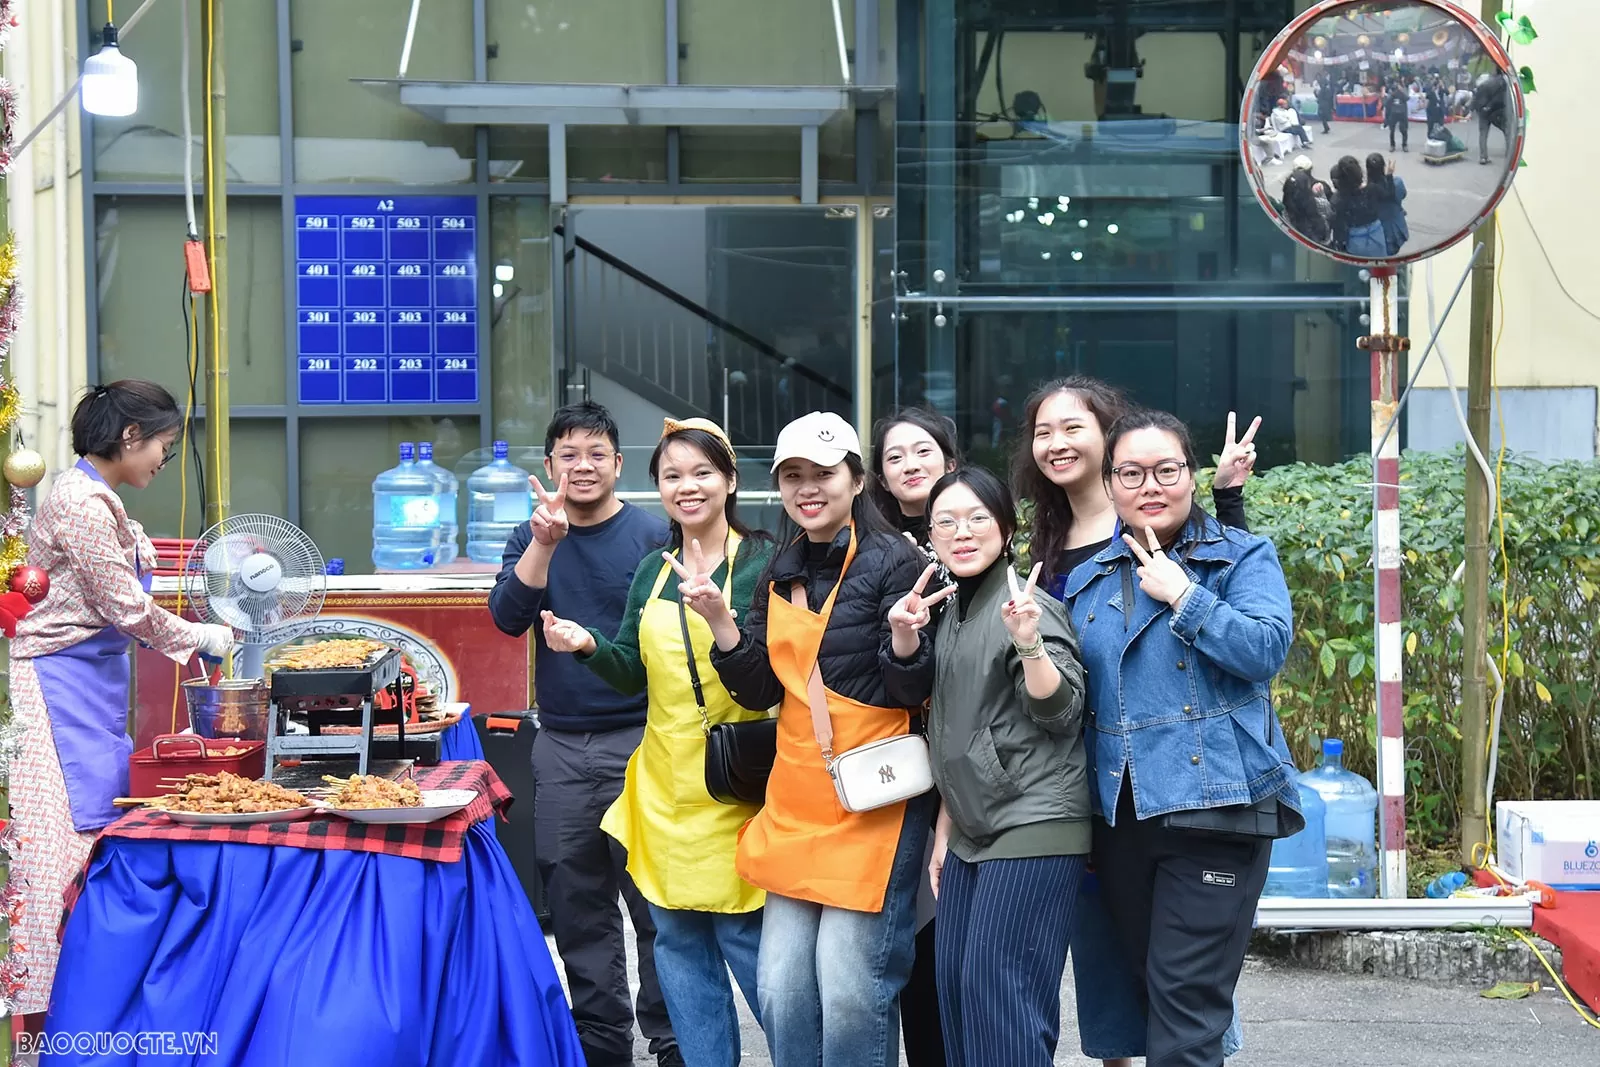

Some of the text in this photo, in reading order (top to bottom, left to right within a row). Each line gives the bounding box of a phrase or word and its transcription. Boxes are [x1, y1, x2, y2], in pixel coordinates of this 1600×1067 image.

[377, 200, 395, 211] A2
[306, 217, 465, 228] 501 502 503 504
[306, 264, 466, 275] 401 402 403 404
[307, 311, 467, 322] 301 302 303 304
[308, 358, 467, 369] 201 202 203 204
[250, 564, 274, 580] nanoco
